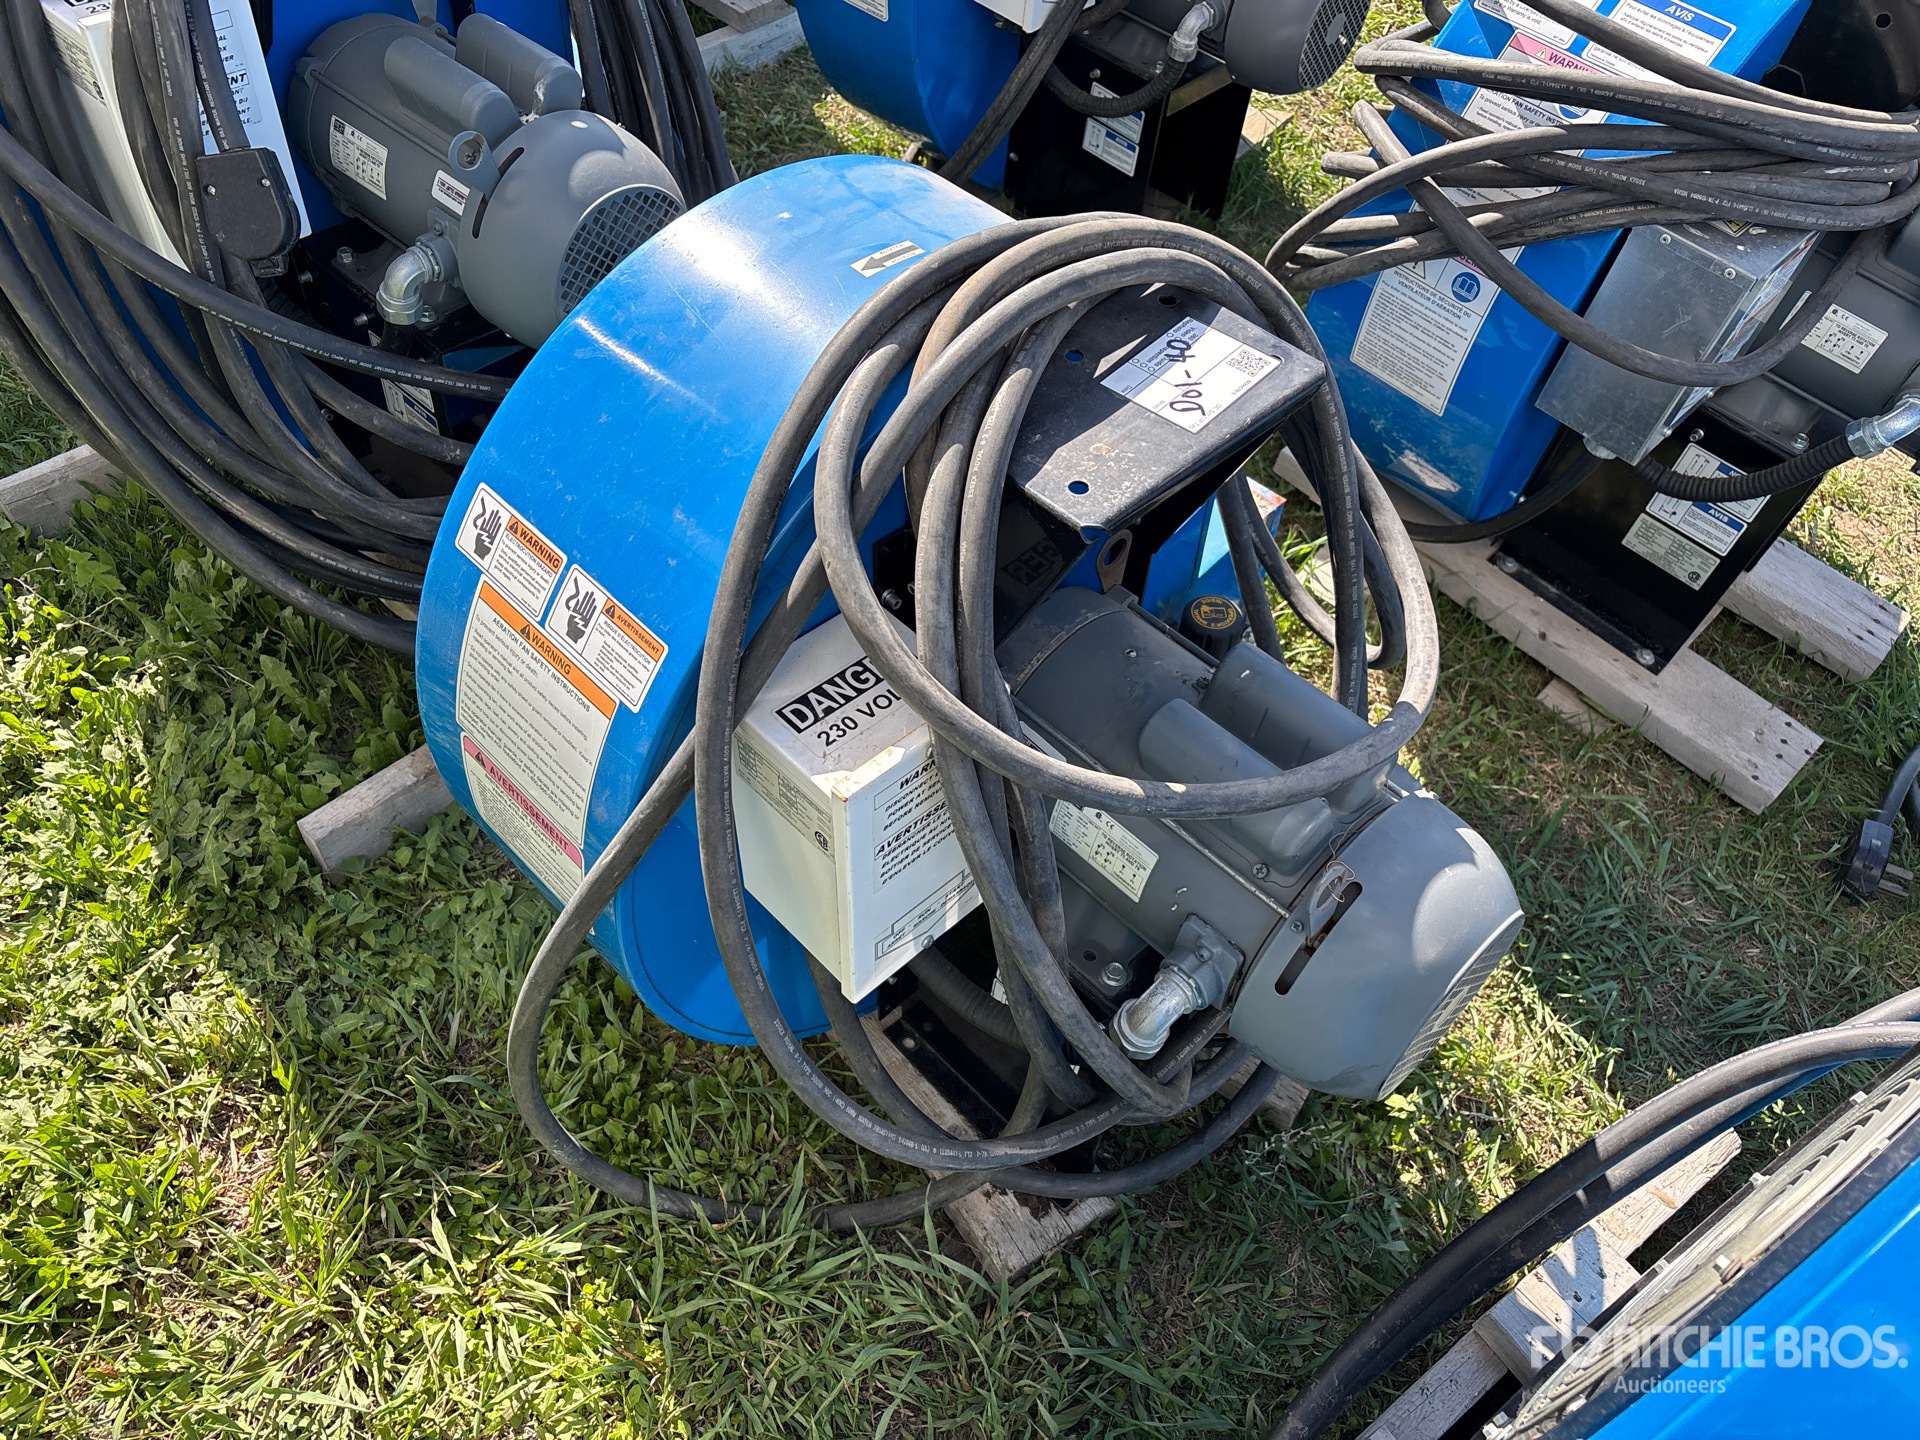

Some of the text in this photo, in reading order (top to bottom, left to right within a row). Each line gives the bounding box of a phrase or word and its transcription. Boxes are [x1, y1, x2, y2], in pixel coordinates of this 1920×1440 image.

[1506, 6, 1526, 17] Warranty
[1636, 7, 1650, 16] éviter
[1655, 16, 1682, 31] dommages
[1665, 5, 1696, 22] AVIS
[1547, 52, 1589, 72] WARN
[198, 64, 221, 126] WATER RESISTANT SOOW
[1482, 96, 1503, 108] prevent
[1499, 105, 1518, 115] serious
[1515, 113, 1530, 122] injury
[1520, 105, 1547, 119] SAFETY
[1610, 172, 1626, 181] ROYAL
[1629, 176, 1645, 185] ESSEX
[1393, 269, 1429, 293] INSTRUCTIONS
[1437, 294, 1463, 313] SÉCURITÉ
[1397, 279, 1461, 319] VENTILATEUR D'AÉRATION
[218, 313, 232, 322] MADE
[1144, 326, 1196, 363] Video nspection
[1840, 326, 1857, 336] REVERSE
[1856, 335, 1876, 347] ROTATION
[373, 364, 396, 374] RESISTANT
[397, 370, 411, 378] WATER
[1152, 356, 1167, 367] luids
[1119, 384, 1132, 393] Date
[1338, 443, 1348, 471] RESISTANT
[966, 447, 984, 498] ESSEX ROYAL
[1708, 506, 1729, 522] AVIS
[504, 542, 516, 555] prevent
[516, 553, 527, 565] serious
[527, 562, 536, 573] injury
[505, 532, 552, 578] ELECTROCUTION HAZARD
[518, 527, 560, 569] WARNING
[603, 619, 617, 634] RISQUE
[616, 613, 659, 654] AVERTISSEMENT
[480, 619, 495, 638] prevent
[494, 633, 509, 651] serious
[508, 646, 520, 662] injury
[531, 631, 572, 676] WARNING
[492, 615, 518, 645] AERATION
[529, 651, 550, 675] SAFETY
[550, 670, 590, 713] INSTRUCTIONS
[523, 675, 537, 693] product
[536, 688, 547, 703] safety
[815, 686, 902, 747] 230 VOL
[885, 774, 934, 812] DISCONNECT
[489, 763, 568, 852] AVERTISSEMENT
[883, 806, 913, 831] BEFORE
[887, 796, 914, 819] POWER
[876, 800, 946, 856] AVERTISSE
[1107, 837, 1125, 854] REVERSE
[1125, 853, 1146, 871] ROTATION
[1113, 871, 1135, 891] THERMOSTAT
